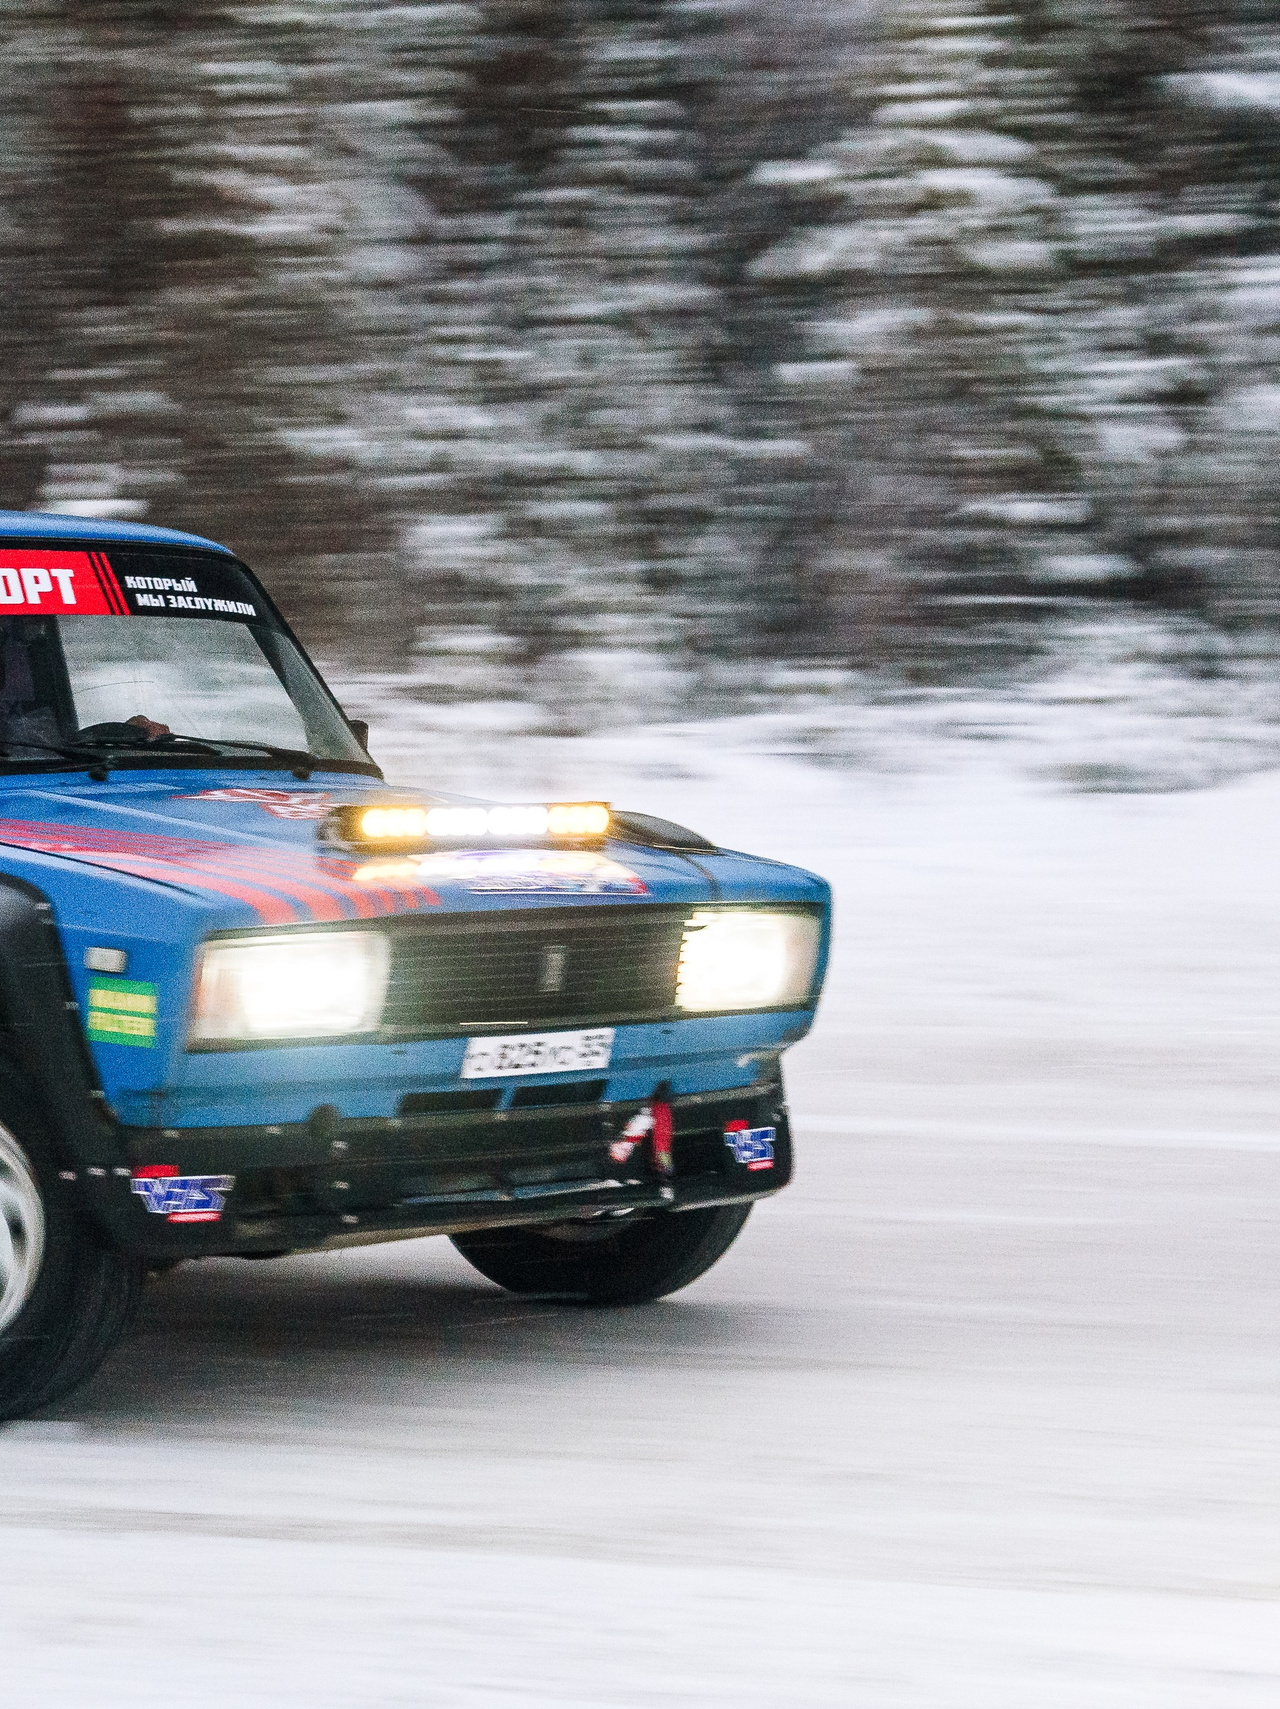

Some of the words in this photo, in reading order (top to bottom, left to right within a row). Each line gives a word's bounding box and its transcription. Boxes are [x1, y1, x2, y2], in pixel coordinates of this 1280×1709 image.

[124, 576, 198, 593] КОТОРЫЙ
[135, 593, 166, 607] МЫ
[166, 595, 257, 616] ЗАСЛУЖИЛИ
